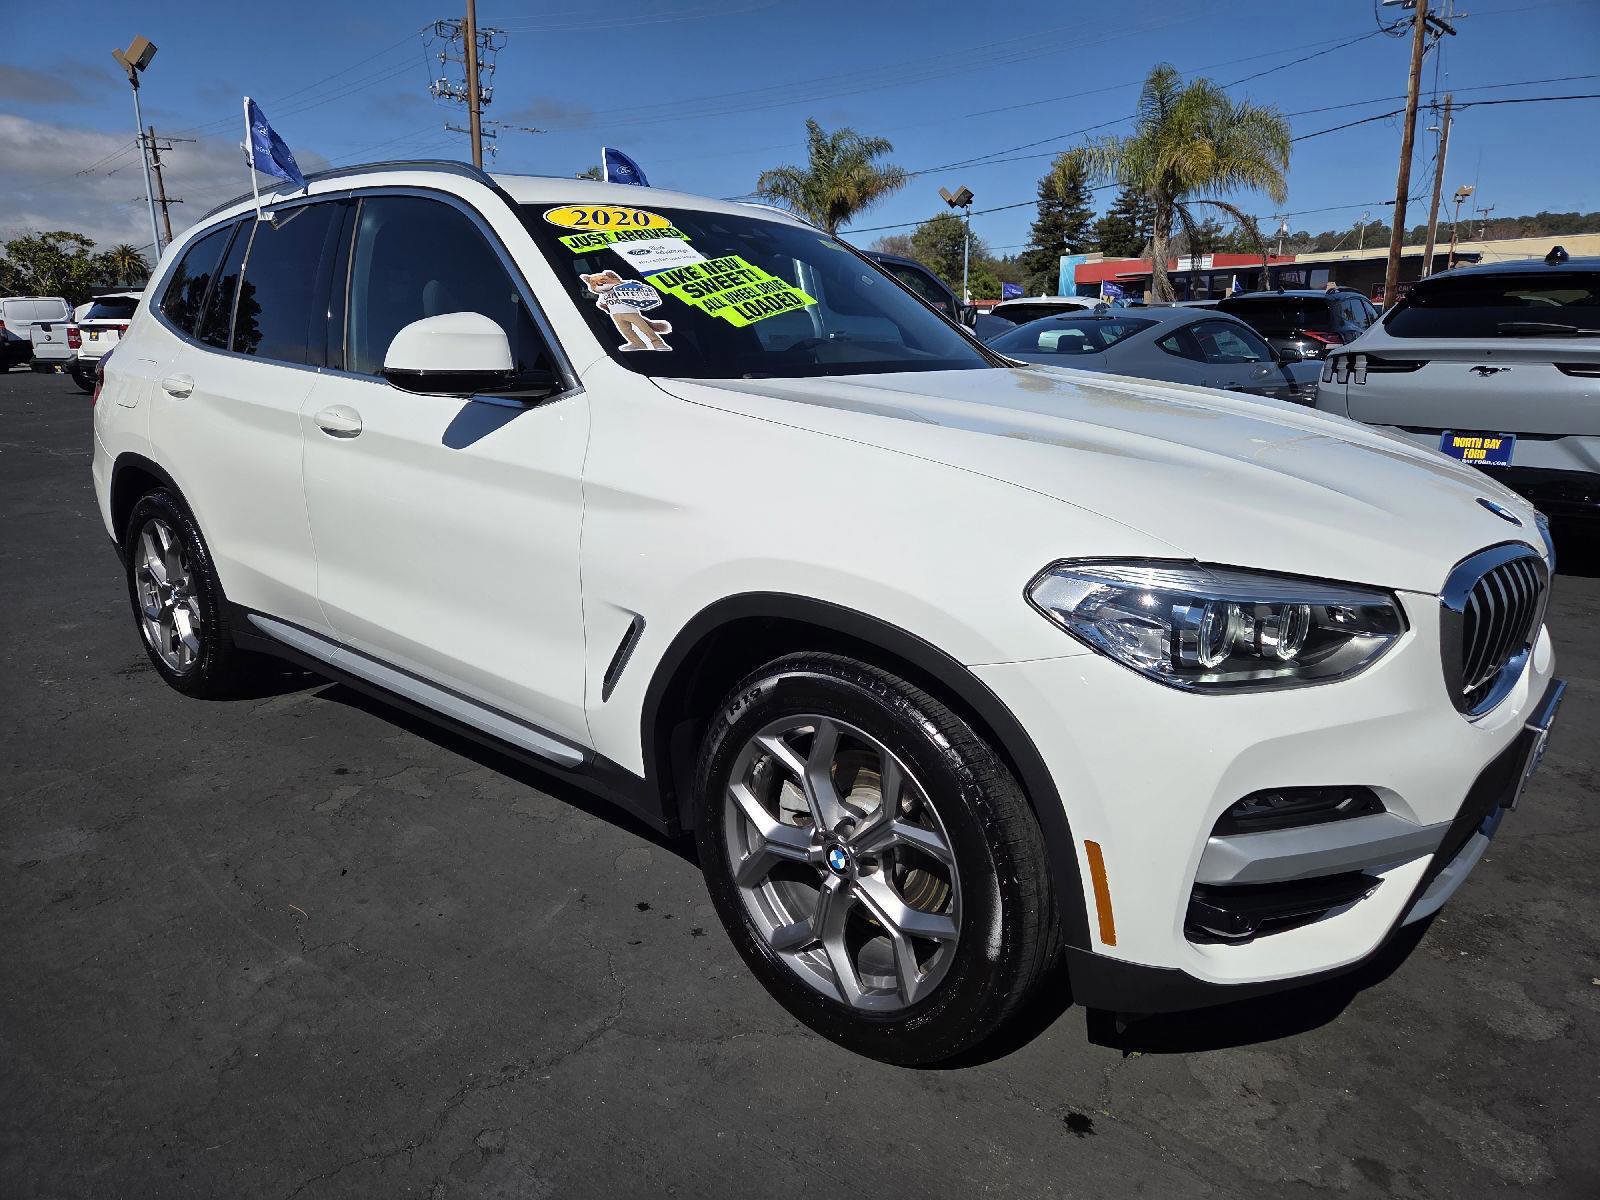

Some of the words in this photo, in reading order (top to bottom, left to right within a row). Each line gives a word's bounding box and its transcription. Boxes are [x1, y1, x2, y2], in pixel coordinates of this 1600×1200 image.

[571, 209, 651, 227] 2020
[569, 232, 610, 249] JUST
[614, 227, 684, 244] ARRIVED
[656, 265, 702, 288] LIKE
[698, 256, 743, 278] NEW
[682, 267, 764, 299] SWEET!
[701, 296, 729, 312] ALL
[724, 287, 763, 305] WHEEL
[758, 278, 792, 294] DRIVE
[731, 290, 807, 321] LOADED
[1453, 437, 1483, 449] NORTH
[1483, 438, 1503, 450] BAY
[1463, 448, 1487, 459] FORD
